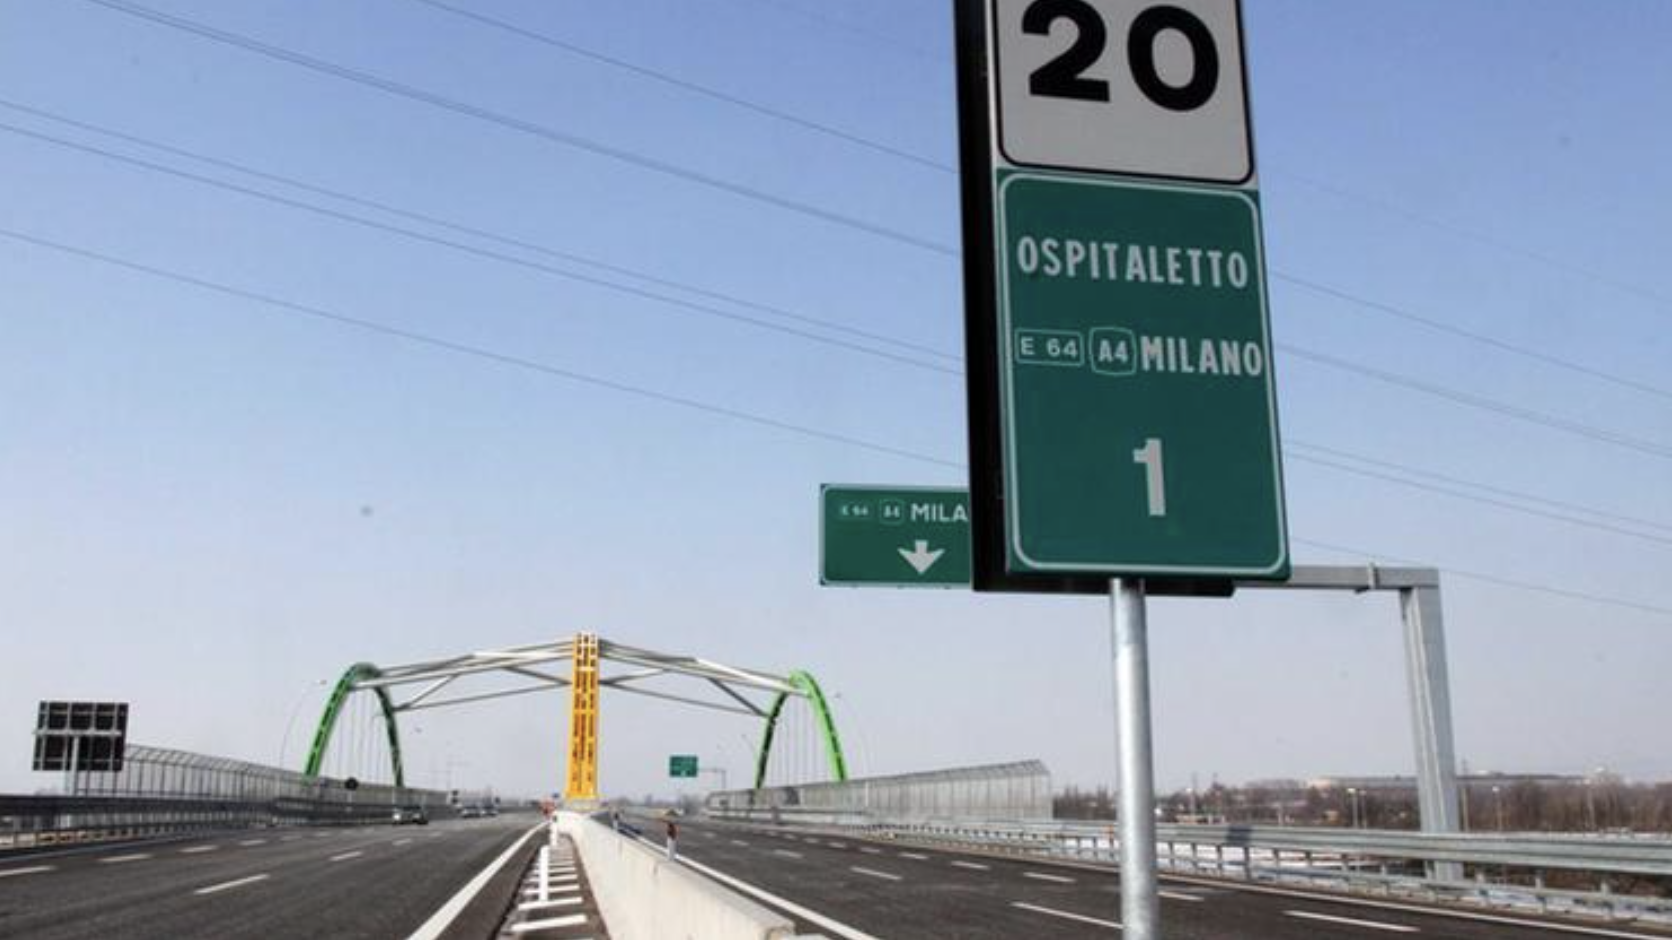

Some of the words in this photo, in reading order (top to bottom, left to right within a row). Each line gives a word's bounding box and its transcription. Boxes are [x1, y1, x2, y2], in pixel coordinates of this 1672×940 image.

[1021, 0, 1220, 113] 20
[1017, 236, 1248, 288] OSPITALETTO
[1020, 337, 1035, 355] E
[1046, 338, 1078, 358] 64
[1099, 340, 1129, 362] A4
[1141, 336, 1263, 376] MILANO
[1133, 438, 1166, 516] 1
